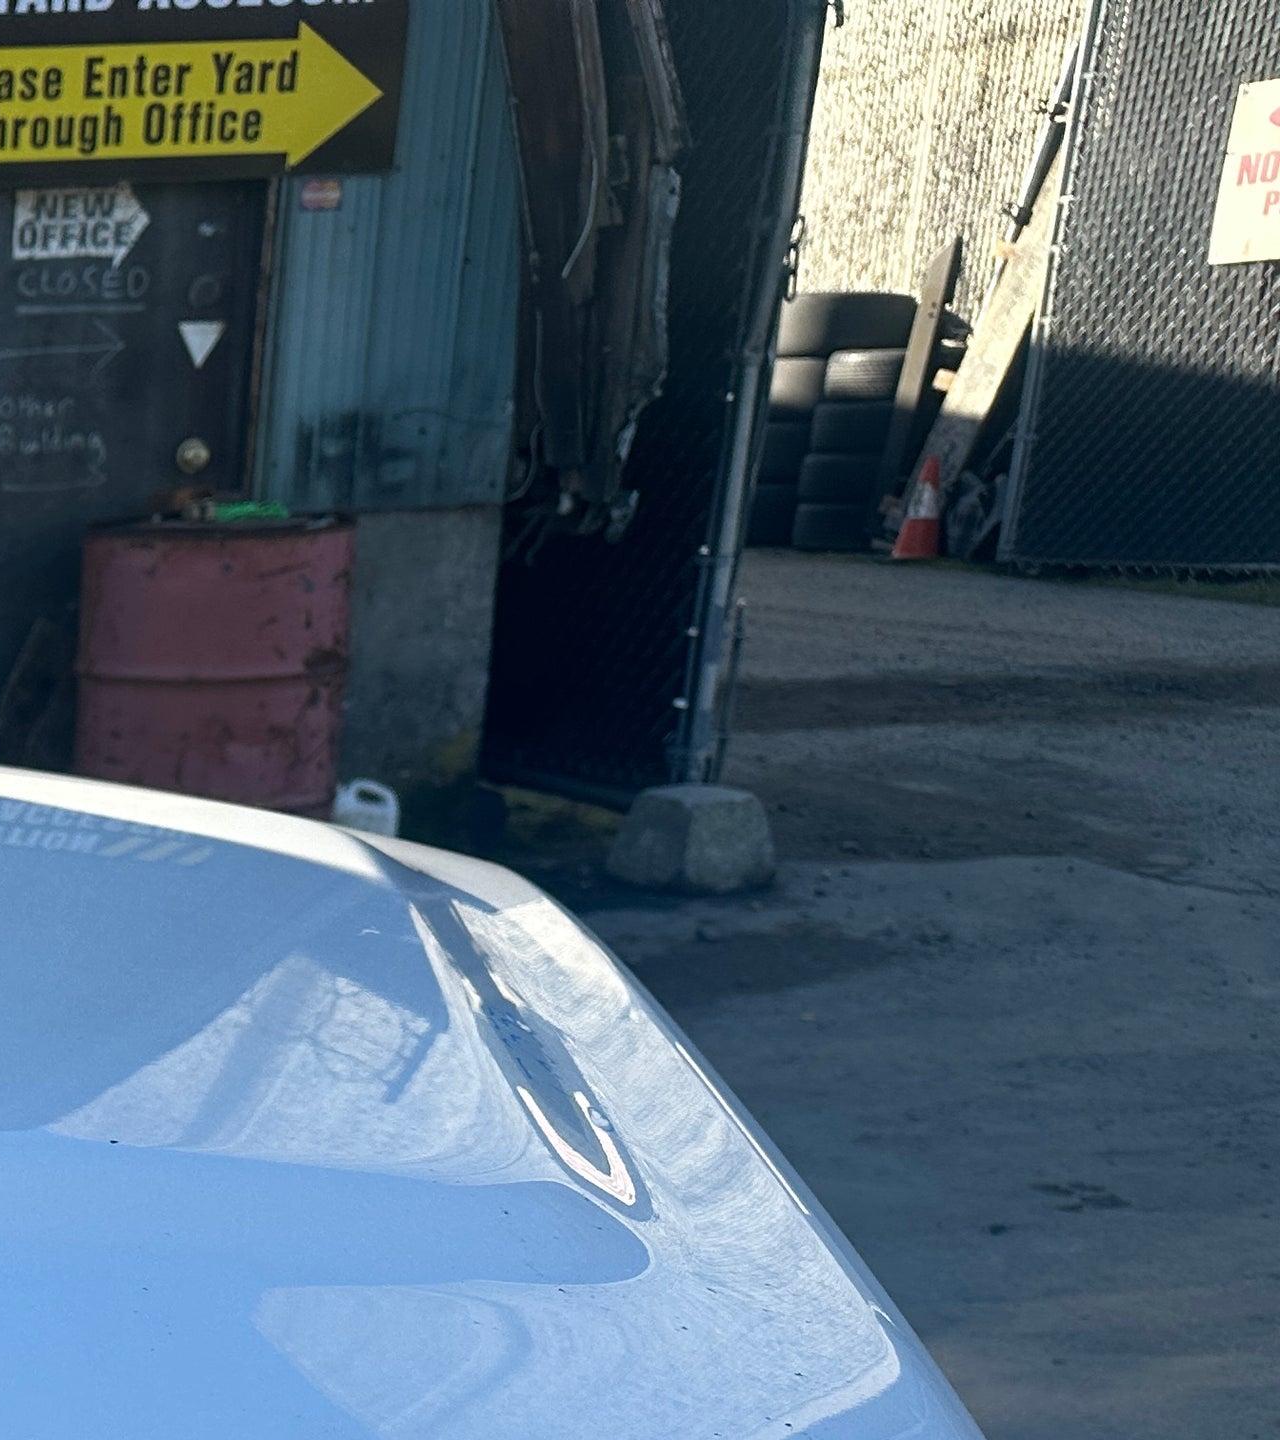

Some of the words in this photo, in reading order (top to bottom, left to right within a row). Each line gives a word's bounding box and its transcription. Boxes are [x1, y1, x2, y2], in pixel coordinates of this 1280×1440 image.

[83, 56, 191, 99] Enter
[212, 50, 300, 96] Yard
[142, 103, 263, 145] Office
[34, 192, 115, 219] NEW
[18, 218, 133, 250] OFFICE
